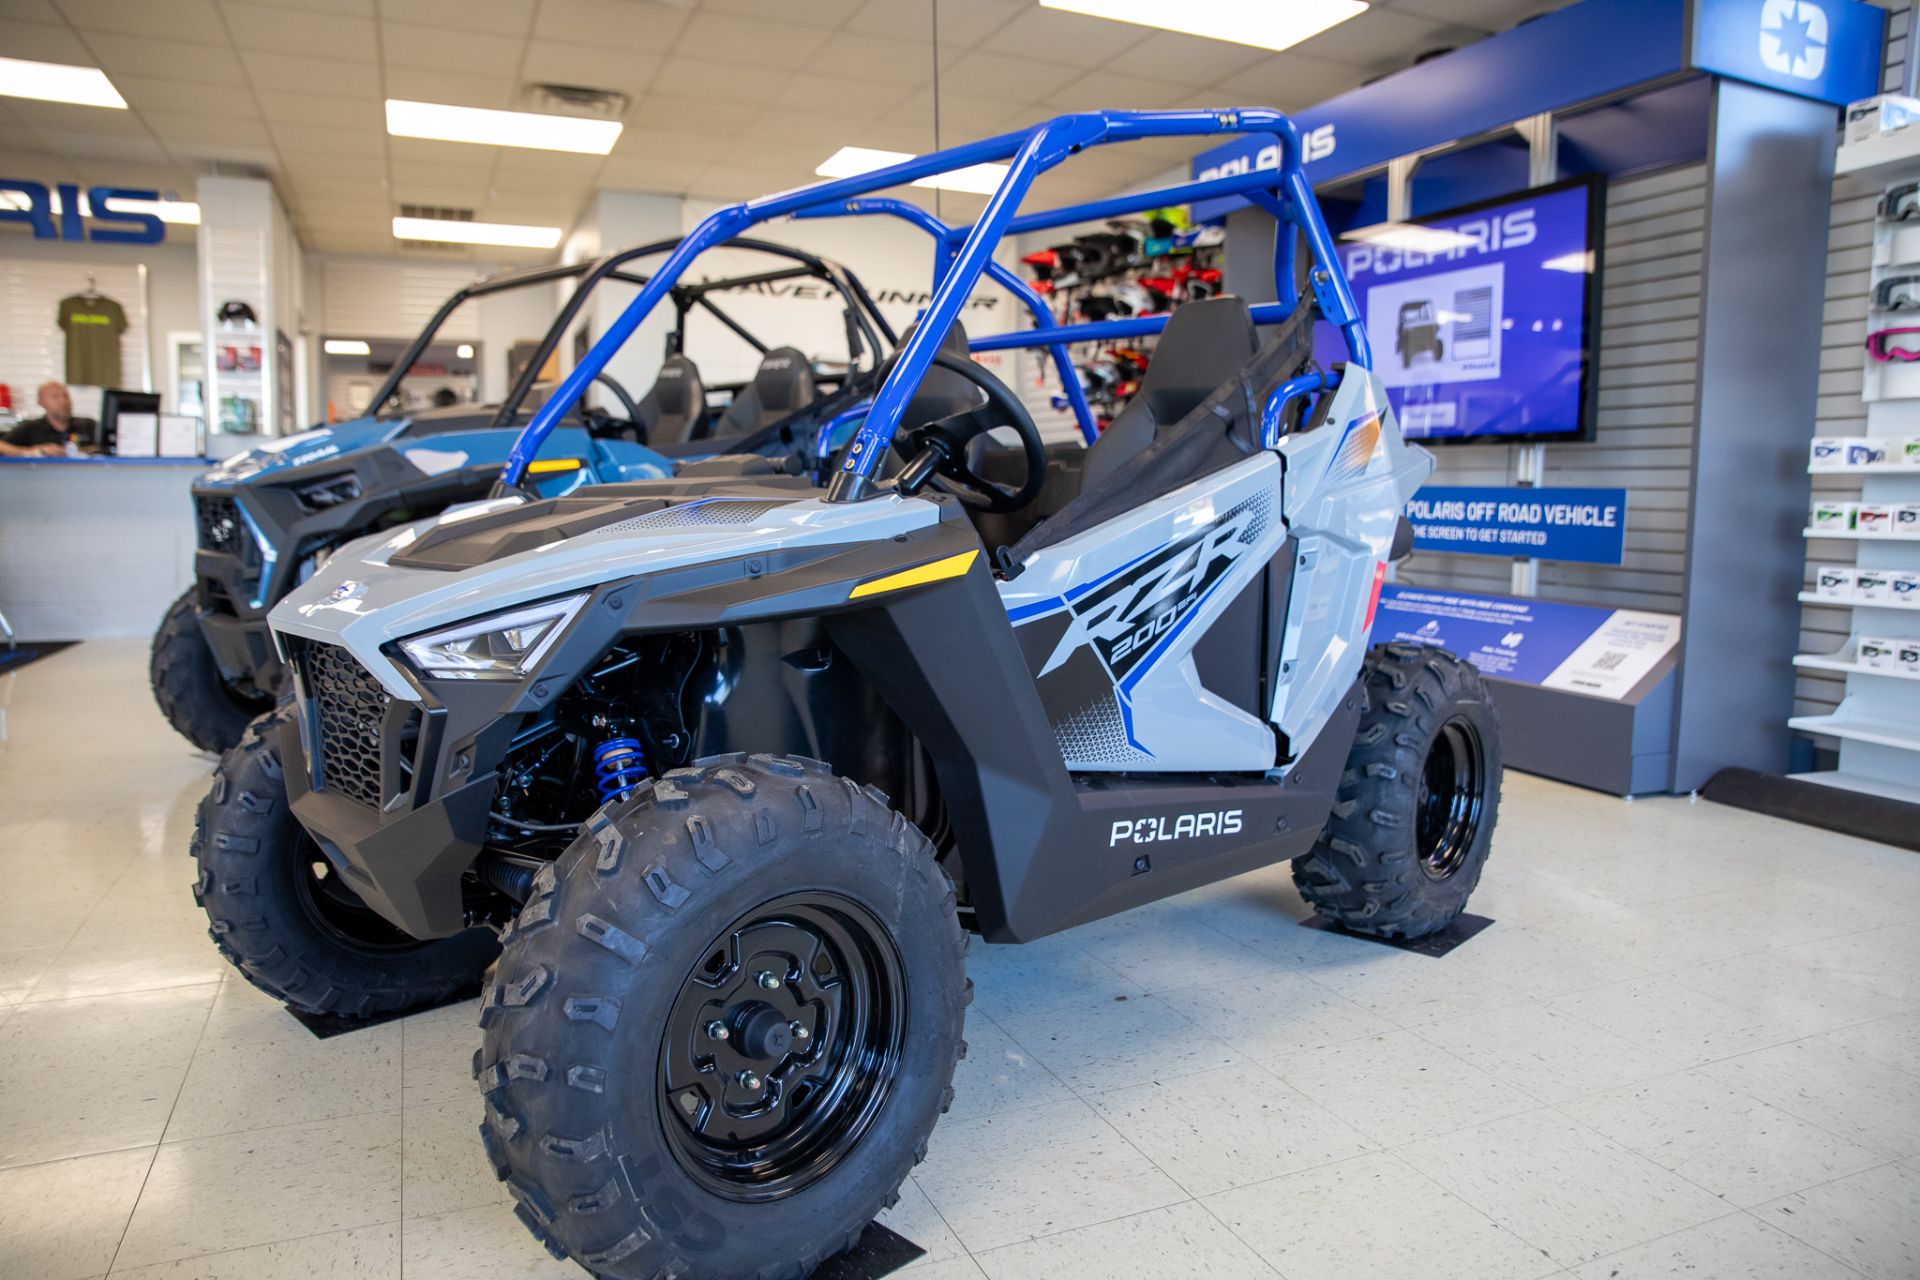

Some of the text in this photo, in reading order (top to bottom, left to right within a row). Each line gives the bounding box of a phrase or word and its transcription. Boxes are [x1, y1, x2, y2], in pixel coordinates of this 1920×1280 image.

[1199, 124, 1337, 182] OLAIS
[1407, 500, 1617, 527] POLARIS OFF ROAD VEHICLE
[1428, 525, 1465, 540] SCREEN
[1465, 529, 1478, 541] TO
[1479, 529, 1499, 542] GET
[1500, 530, 1548, 546] STARTED
[1037, 509, 1254, 679] RZR
[1109, 809, 1243, 848] POLARIS
